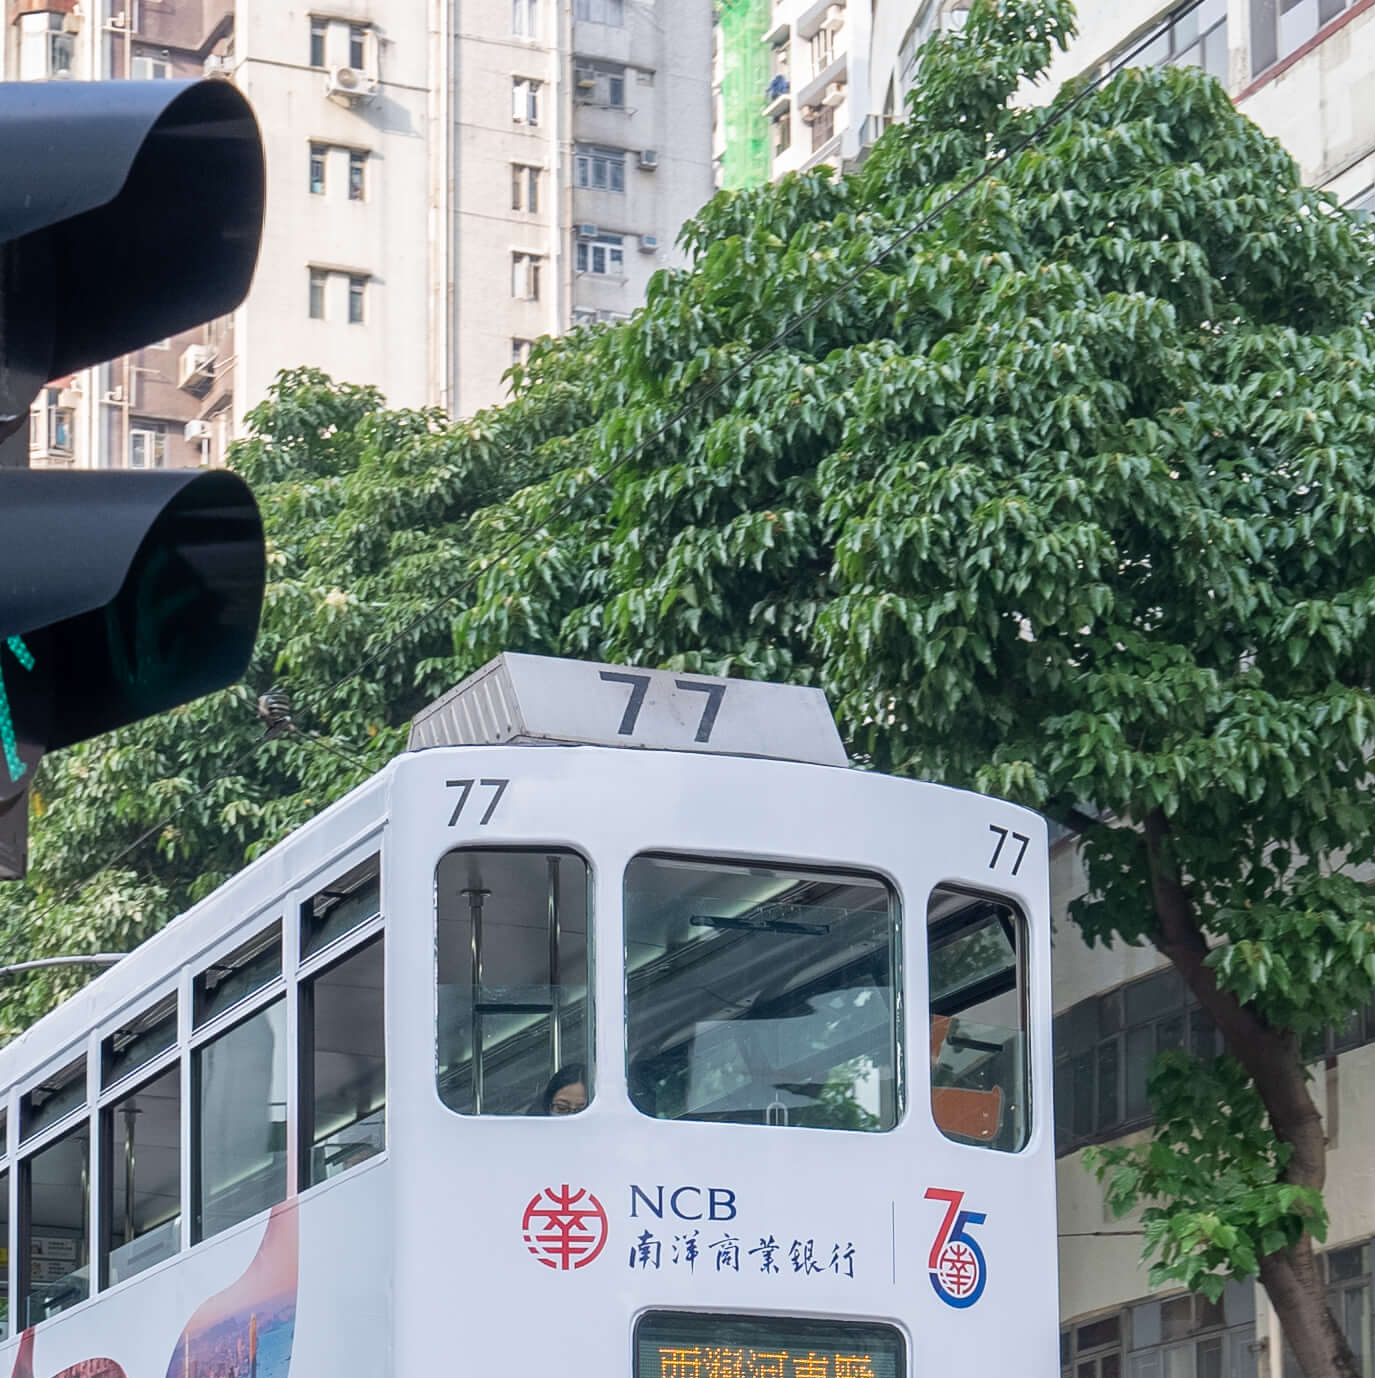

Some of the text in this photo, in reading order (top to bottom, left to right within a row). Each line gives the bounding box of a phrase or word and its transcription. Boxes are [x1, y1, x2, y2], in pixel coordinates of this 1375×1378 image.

[598, 670, 728, 743] 77
[444, 779, 510, 827] 77
[987, 824, 1031, 876] 77
[629, 1184, 738, 1221] NCB
[628, 1229, 856, 1279] 南洋商業銀行
[924, 1187, 987, 1309] 75
